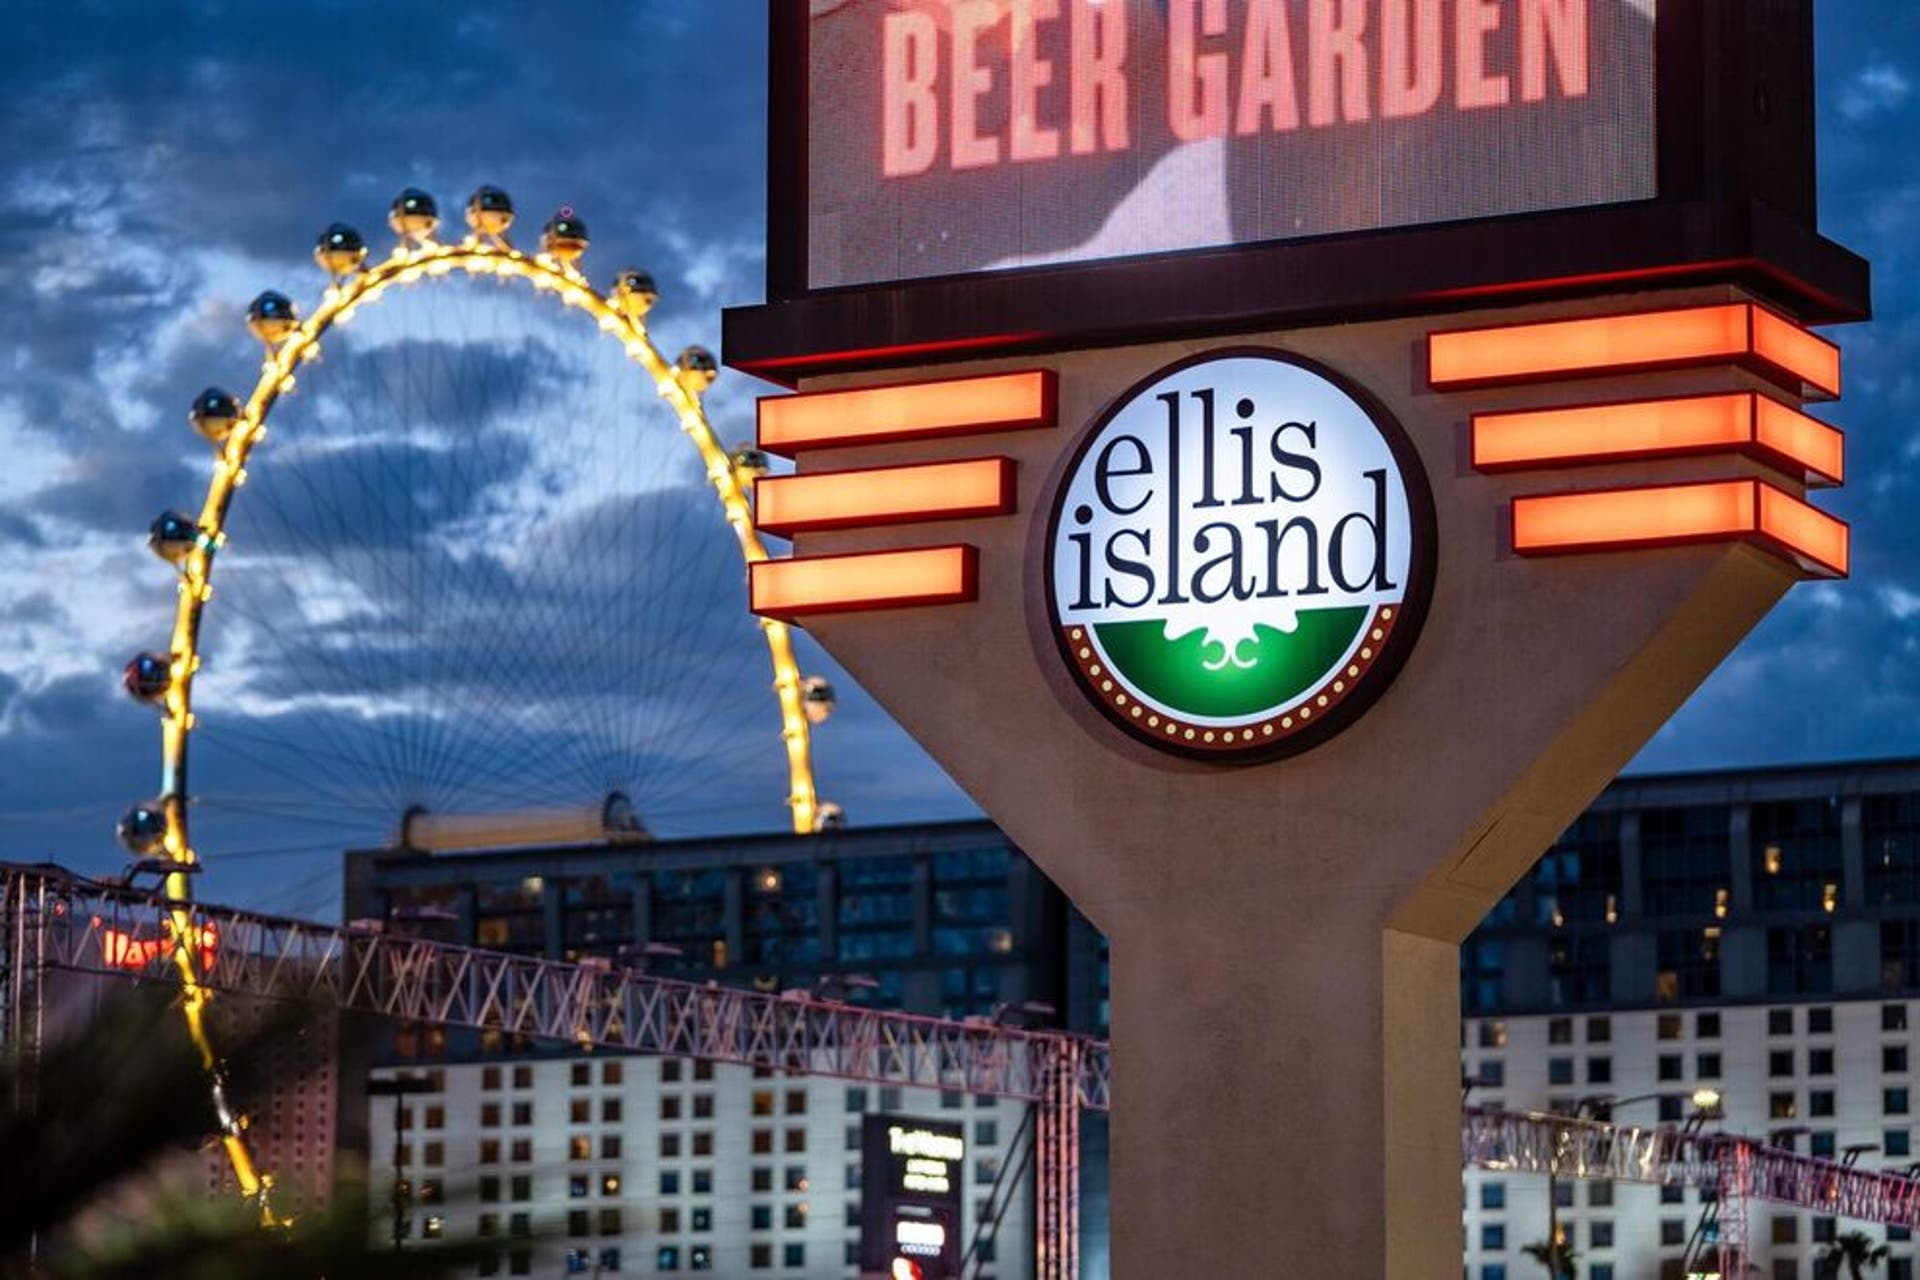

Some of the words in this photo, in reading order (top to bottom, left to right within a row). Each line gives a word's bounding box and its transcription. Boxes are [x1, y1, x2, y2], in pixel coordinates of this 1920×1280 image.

[882, 0, 1130, 178] BEER
[1166, 0, 1590, 142] GARDEN
[1094, 387, 1322, 516] ellis
[1067, 467, 1398, 612] island
